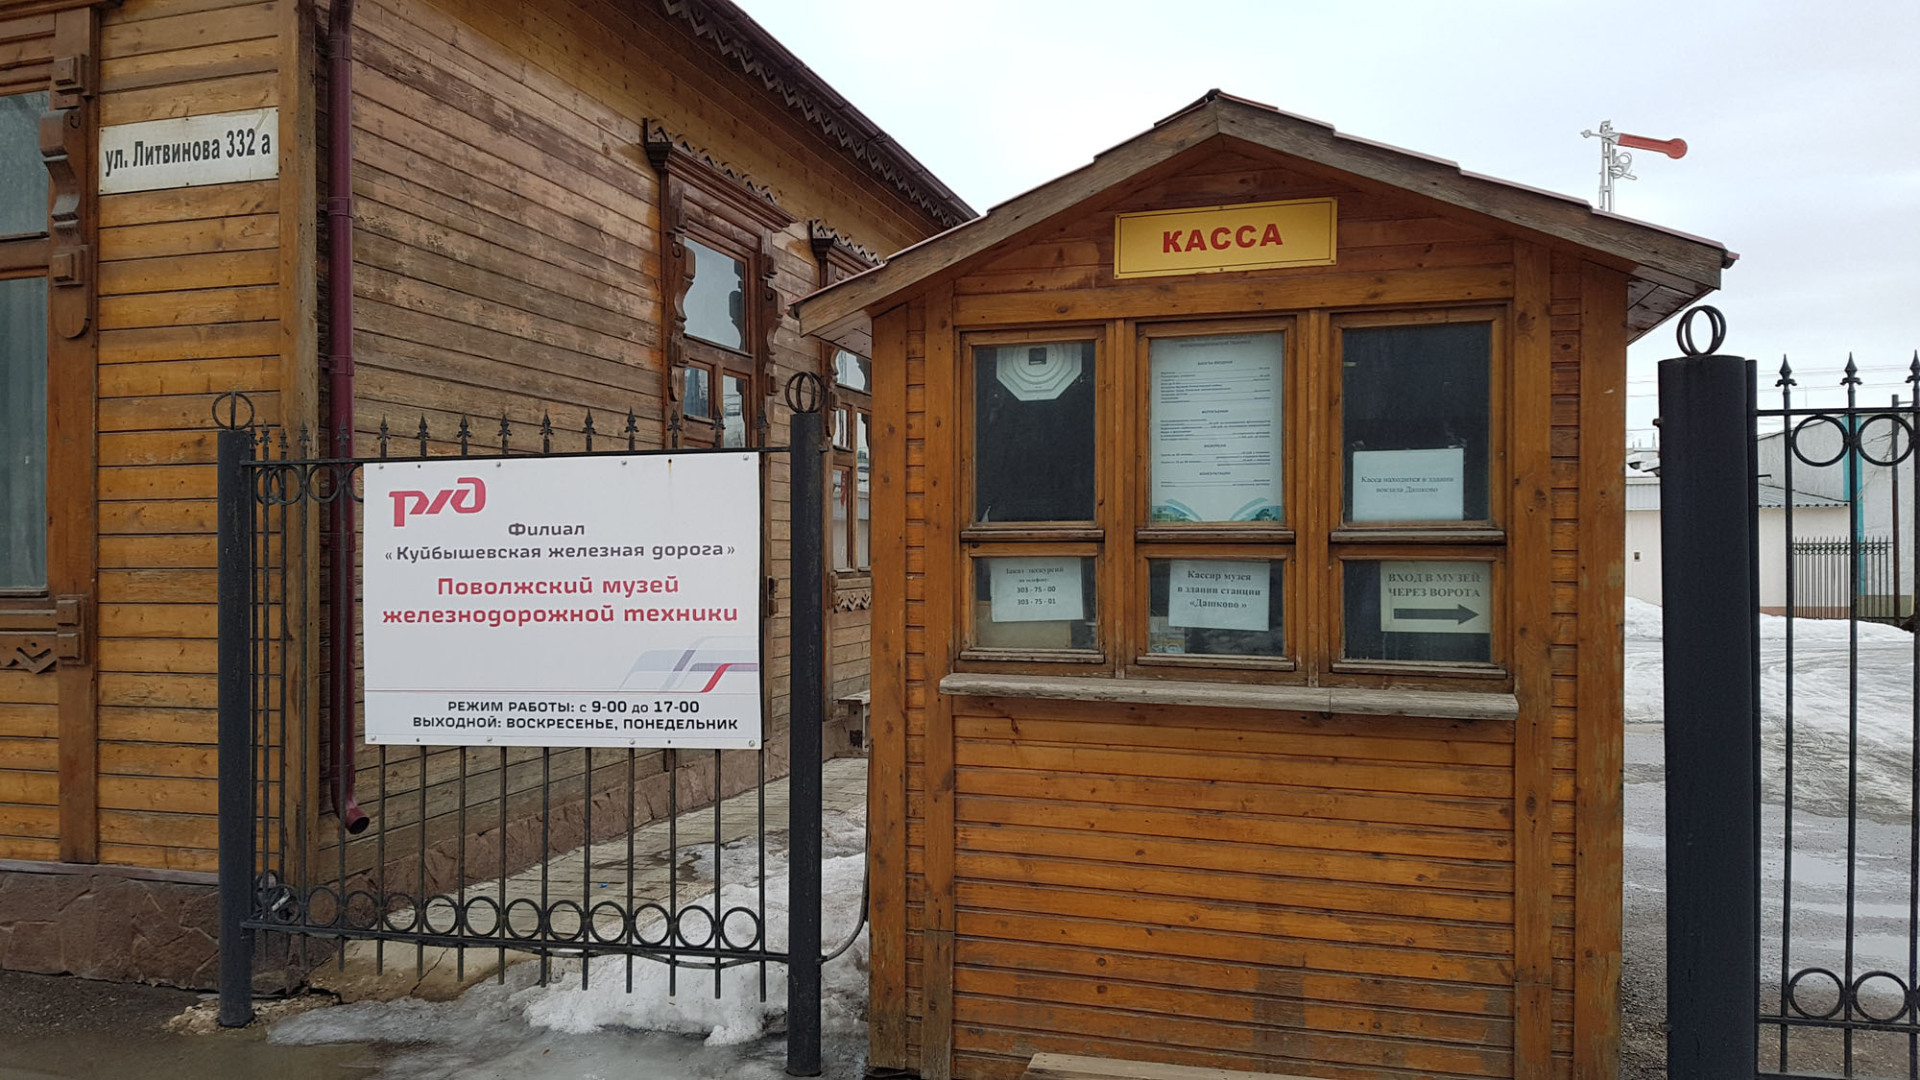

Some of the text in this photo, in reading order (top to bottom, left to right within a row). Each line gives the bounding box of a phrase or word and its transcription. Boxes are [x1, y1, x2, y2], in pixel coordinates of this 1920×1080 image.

[105, 128, 271, 177] ул. Литвинова 332 а
[1162, 223, 1283, 253] КАССА
[508, 522, 585, 536] Филиал
[548, 545, 645, 558] железная
[1187, 570, 1251, 582] Кассир музея
[1388, 571, 1481, 583] ВХОД В МУЗЕЙ
[437, 575, 679, 598] Поволжский музей
[1221, 588, 1261, 596] станции
[1388, 588, 1481, 597] ЧЕРЕЗ ВОРОТА
[382, 604, 738, 628] железнодорожной техники
[448, 700, 700, 714] РЕЖИМ РАБОТЫ: с 9-00 до 17-00
[413, 715, 738, 731] ВЫХОДНОЙ: ВОСКРЕСЕНЬЕ, ПОНЕДЕЛЬНИК
